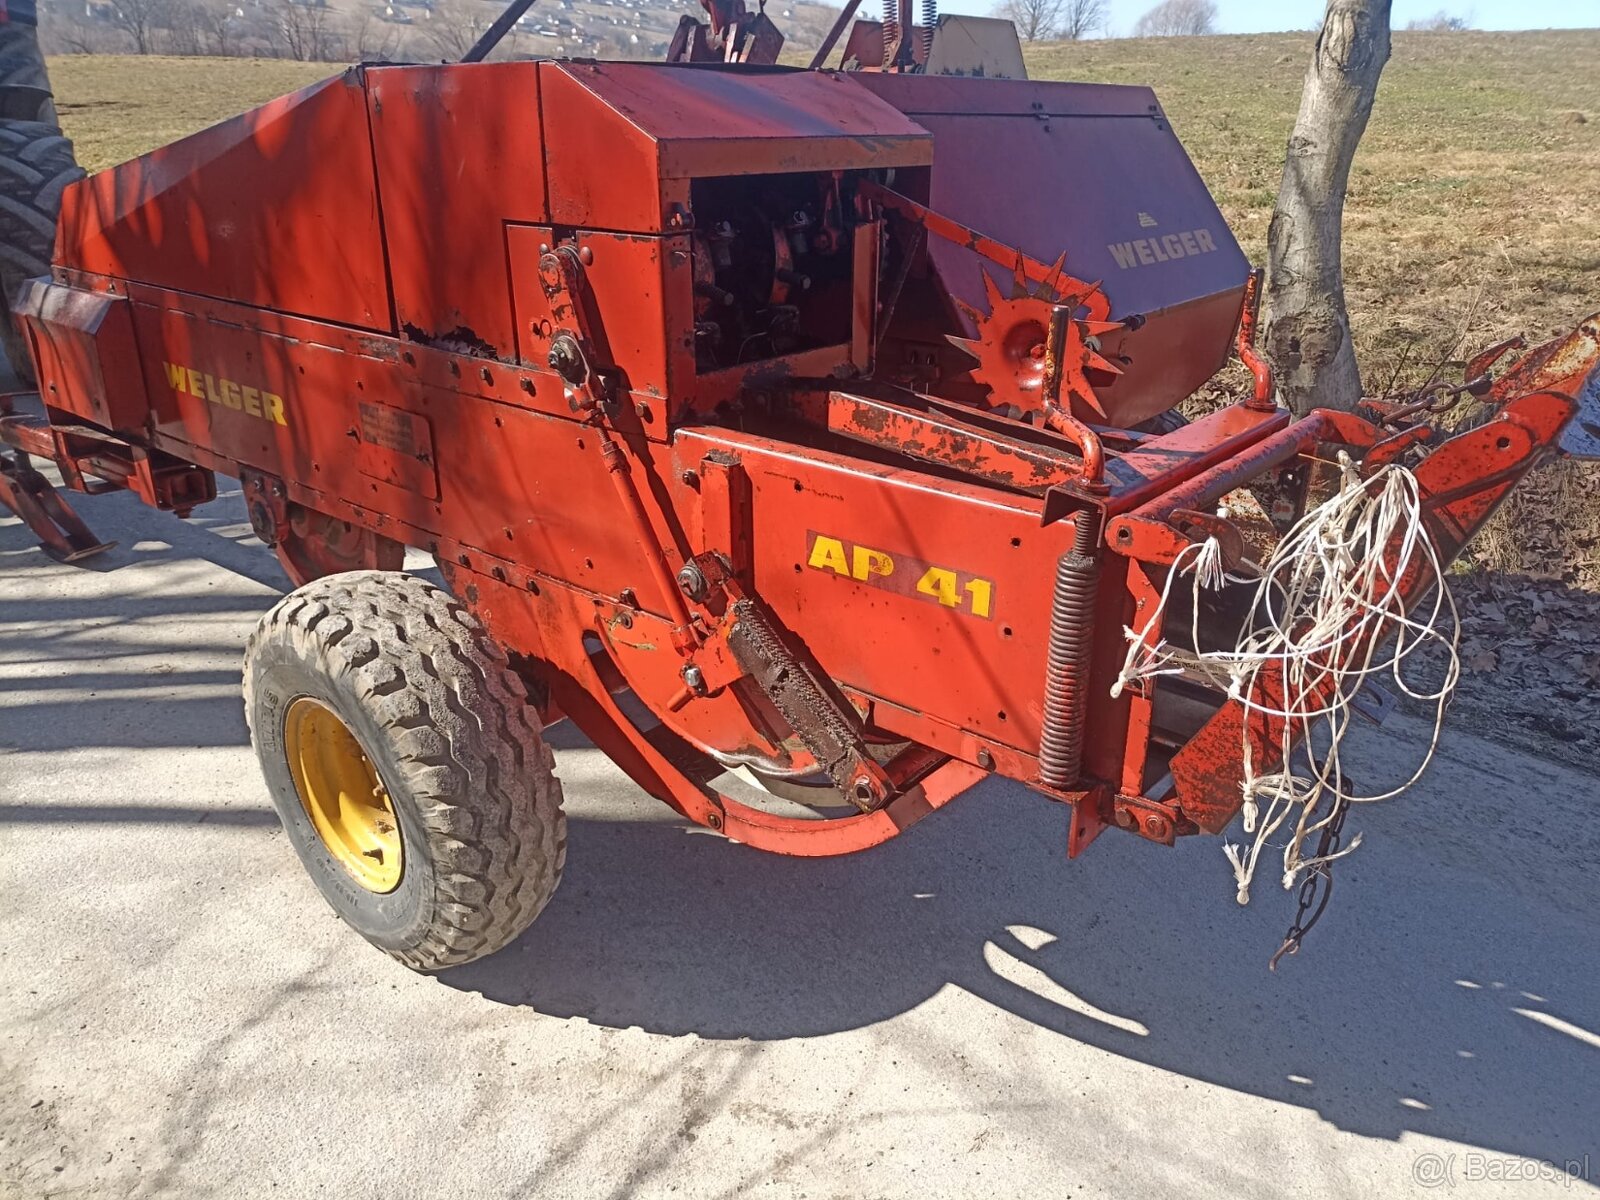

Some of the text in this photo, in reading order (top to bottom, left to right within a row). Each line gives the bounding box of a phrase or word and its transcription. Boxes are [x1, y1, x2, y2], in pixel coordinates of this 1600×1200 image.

[1107, 229, 1217, 269] WELGER
[163, 361, 287, 426] WELGER
[808, 535, 991, 618] AP 41
